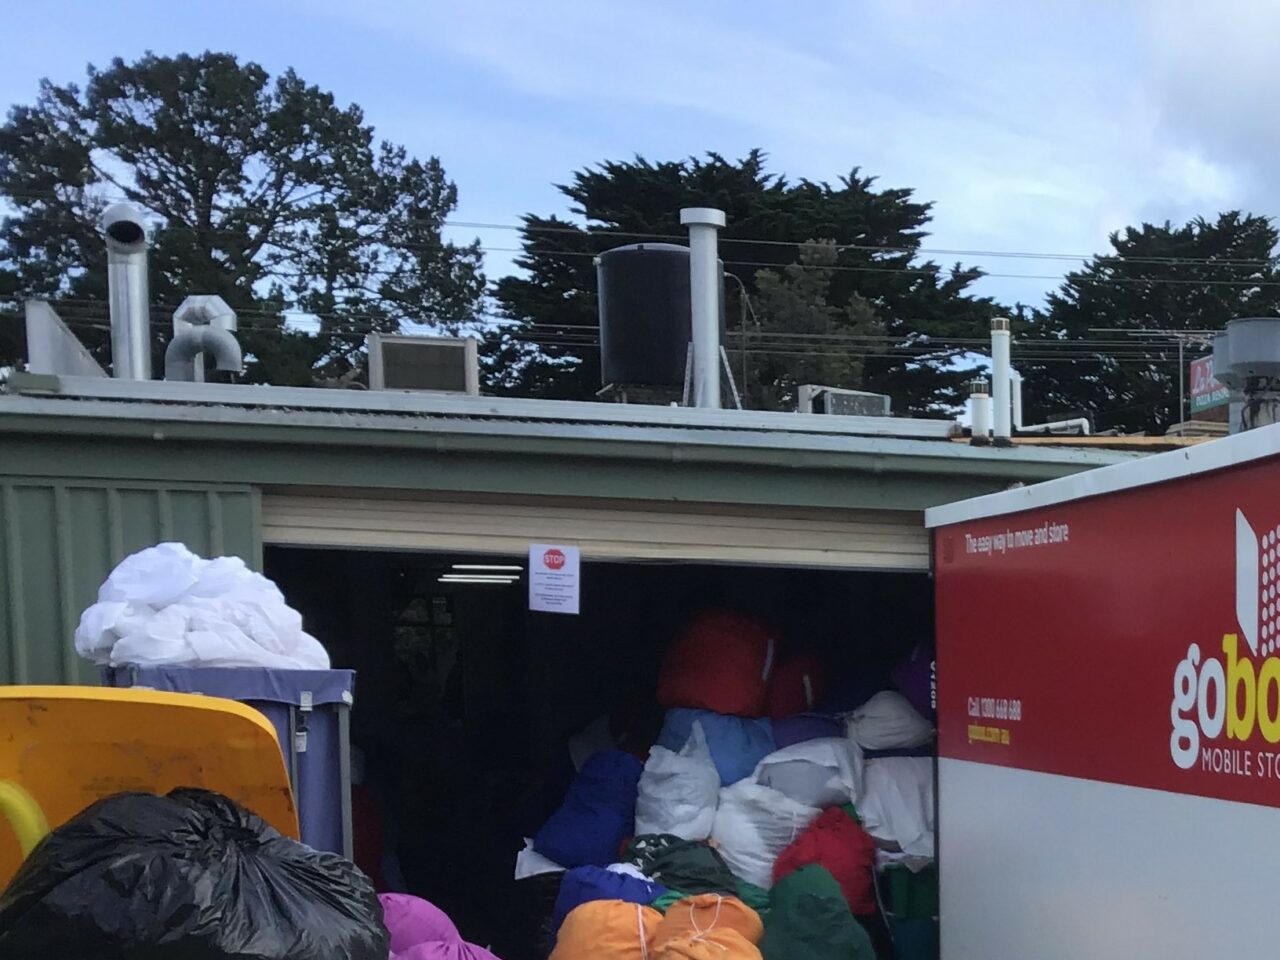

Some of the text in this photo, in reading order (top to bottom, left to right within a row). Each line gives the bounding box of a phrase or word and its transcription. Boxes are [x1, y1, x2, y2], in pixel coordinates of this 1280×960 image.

[965, 534, 977, 554] The
[978, 536, 992, 556] easy
[993, 533, 1006, 554] way
[1014, 529, 1034, 548] move
[1034, 521, 1048, 545] and
[1048, 521, 1069, 543] store
[544, 554, 564, 564] STOP
[1202, 747, 1252, 776] MOBILE
